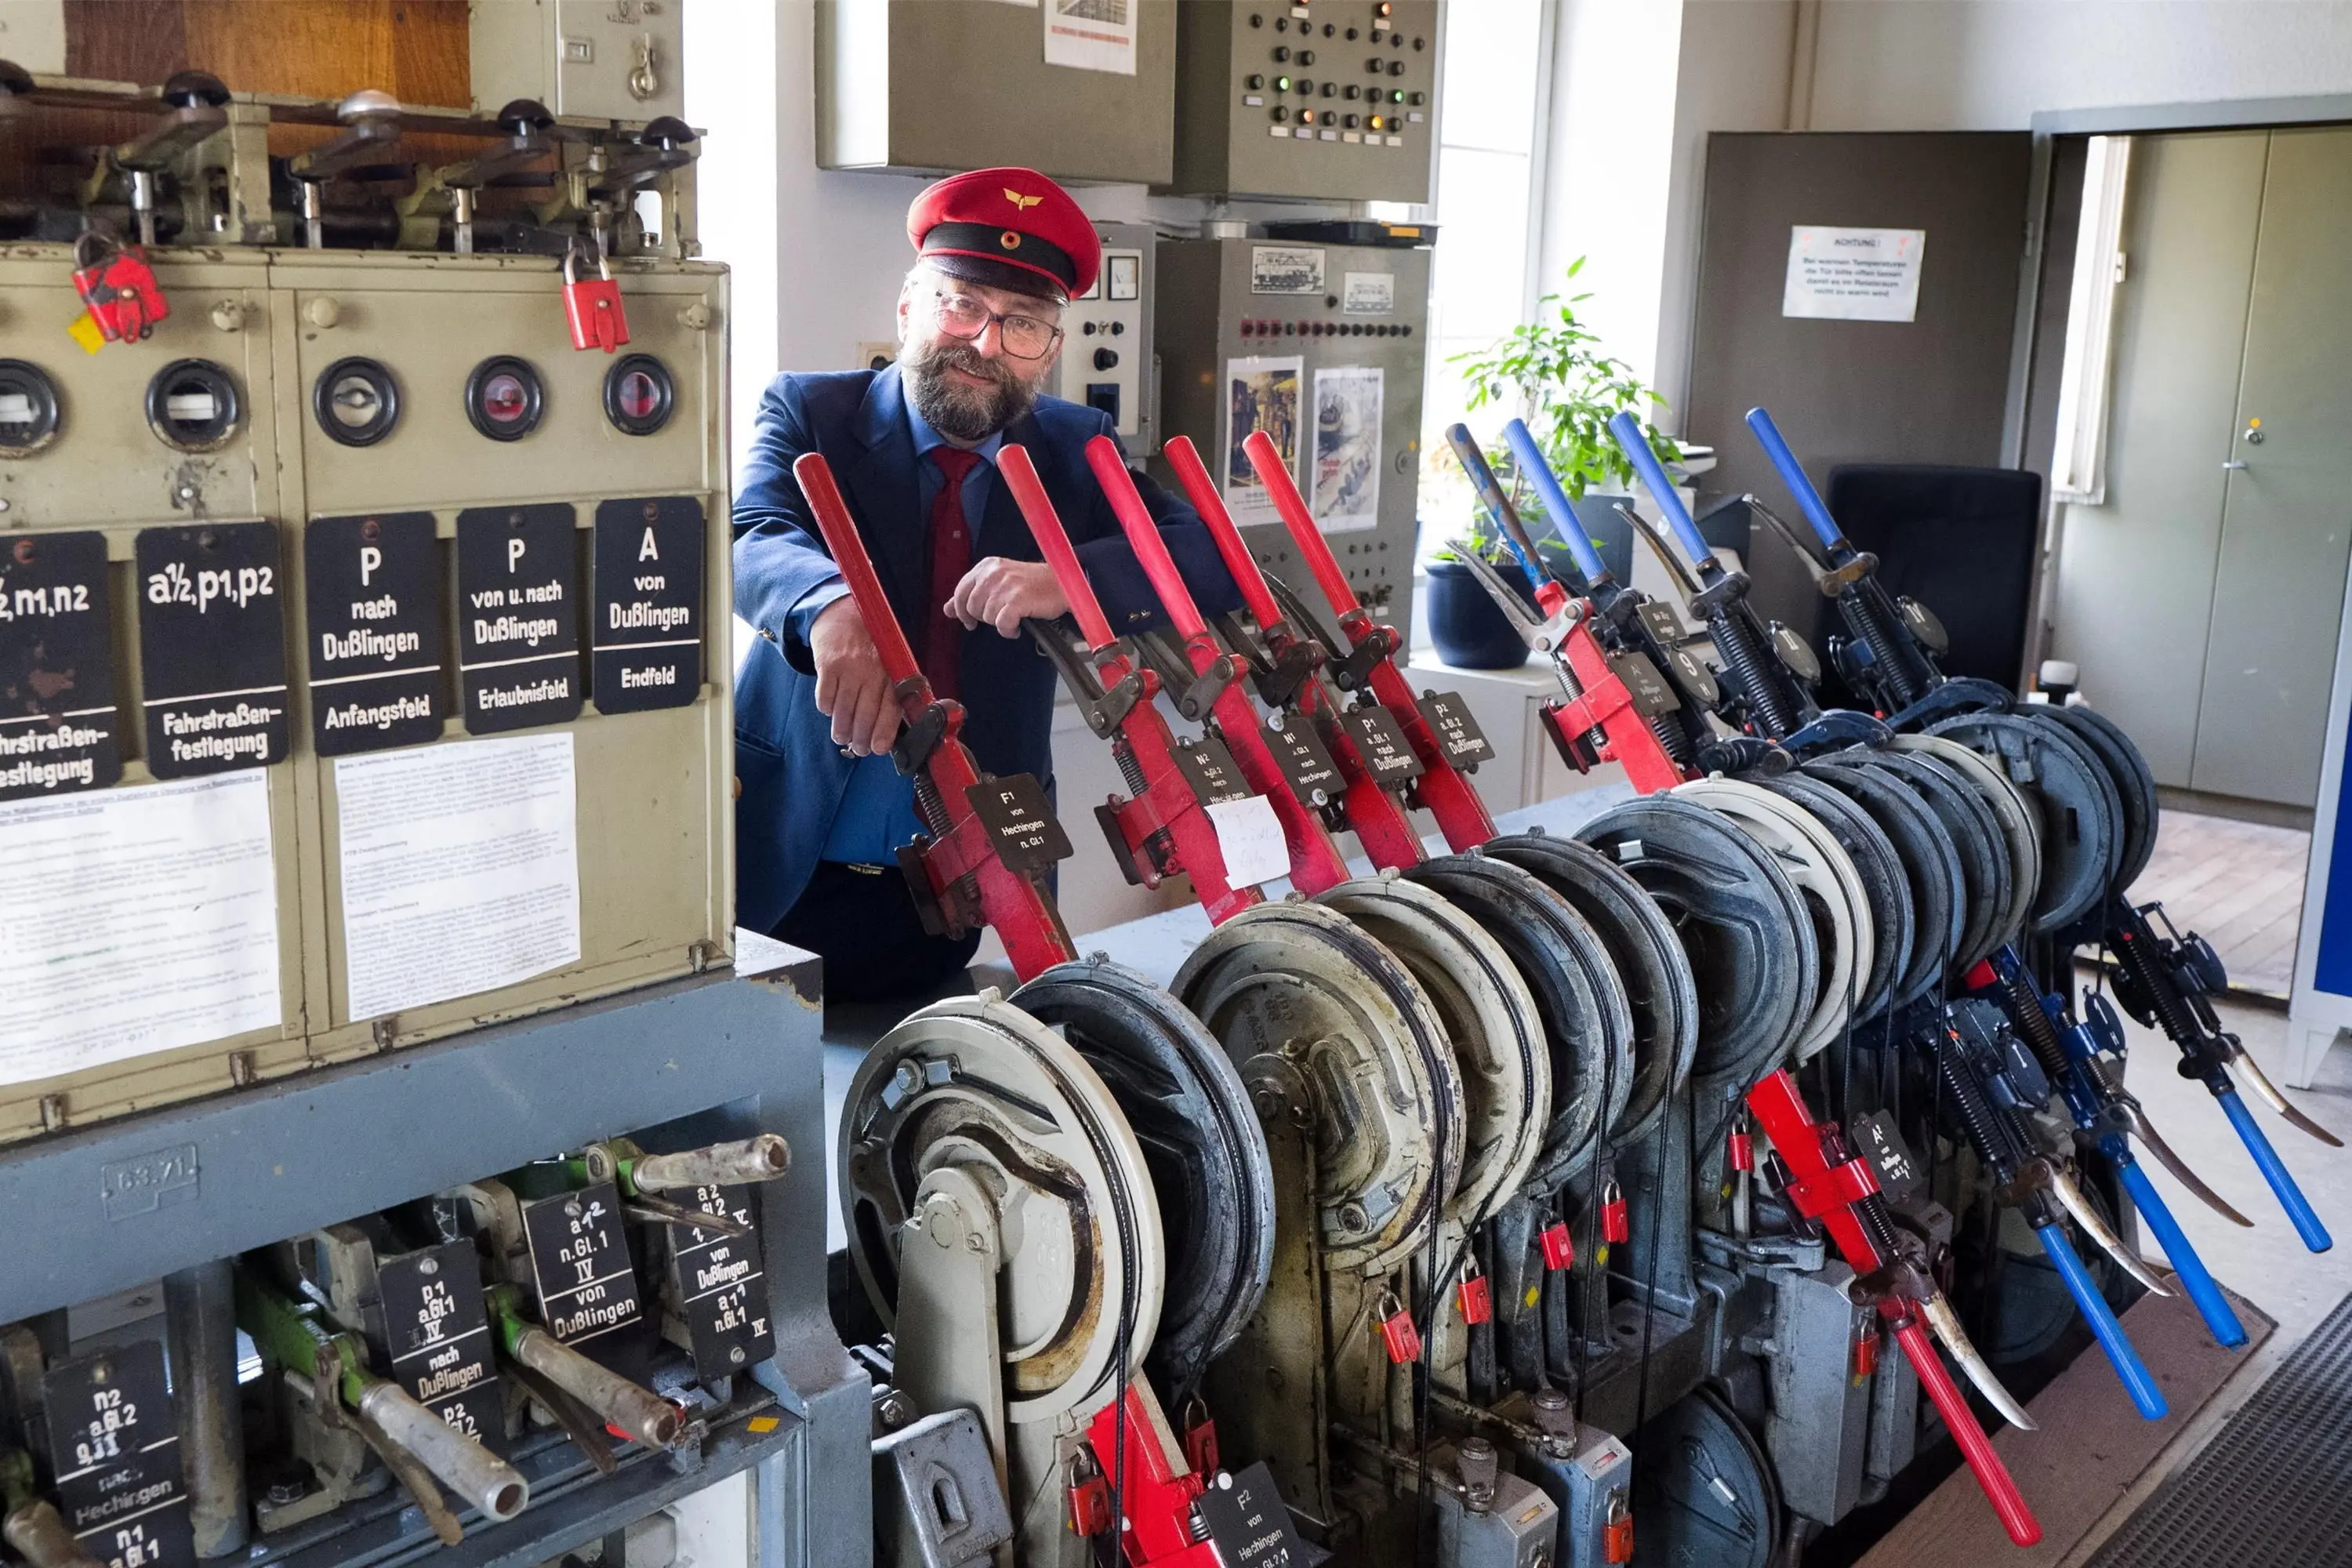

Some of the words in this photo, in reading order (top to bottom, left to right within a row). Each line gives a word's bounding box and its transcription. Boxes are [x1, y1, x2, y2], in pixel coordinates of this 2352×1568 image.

[509, 538, 526, 573] P
[638, 526, 659, 562] A
[360, 546, 383, 586] P
[470, 590, 505, 609] von
[508, 587, 524, 605] u.
[525, 579, 563, 604] nach
[633, 575, 666, 592] von
[351, 594, 397, 620] nach
[608, 601, 690, 632] Dußlingen
[474, 617, 558, 647] Dußlingen
[322, 630, 419, 662] Dußlingen
[621, 666, 677, 689] Endfeld
[478, 677, 569, 710] Erlaubnisfeld
[163, 703, 283, 737] Fahrstraßen-
[325, 695, 431, 731] Anfangsfeld
[1435, 703, 1450, 718] P2
[1362, 718, 1377, 733] P1
[1449, 728, 1465, 739] nach
[170, 731, 270, 762] festlegung
[1195, 753, 1210, 766] N2
[1376, 744, 1396, 755] nach
[1448, 738, 1486, 755] Dußlingen
[1373, 754, 1414, 771] Dußlingen
[1298, 769, 1333, 785] Hechingen
[1000, 791, 1015, 804] F1
[1010, 808, 1025, 817] von
[1000, 820, 1045, 837] Hechingen
[710, 1247, 730, 1263] von
[574, 1258, 595, 1284] IV
[697, 1259, 750, 1290] Dußlingen
[575, 1283, 606, 1306] von
[554, 1297, 636, 1339] Dußlingen
[428, 1345, 460, 1371] nach
[418, 1362, 483, 1400] Dußlingen
[1236, 1489, 1252, 1512] F2
[1247, 1513, 1263, 1528] von
[1238, 1529, 1283, 1562] Hechingen
